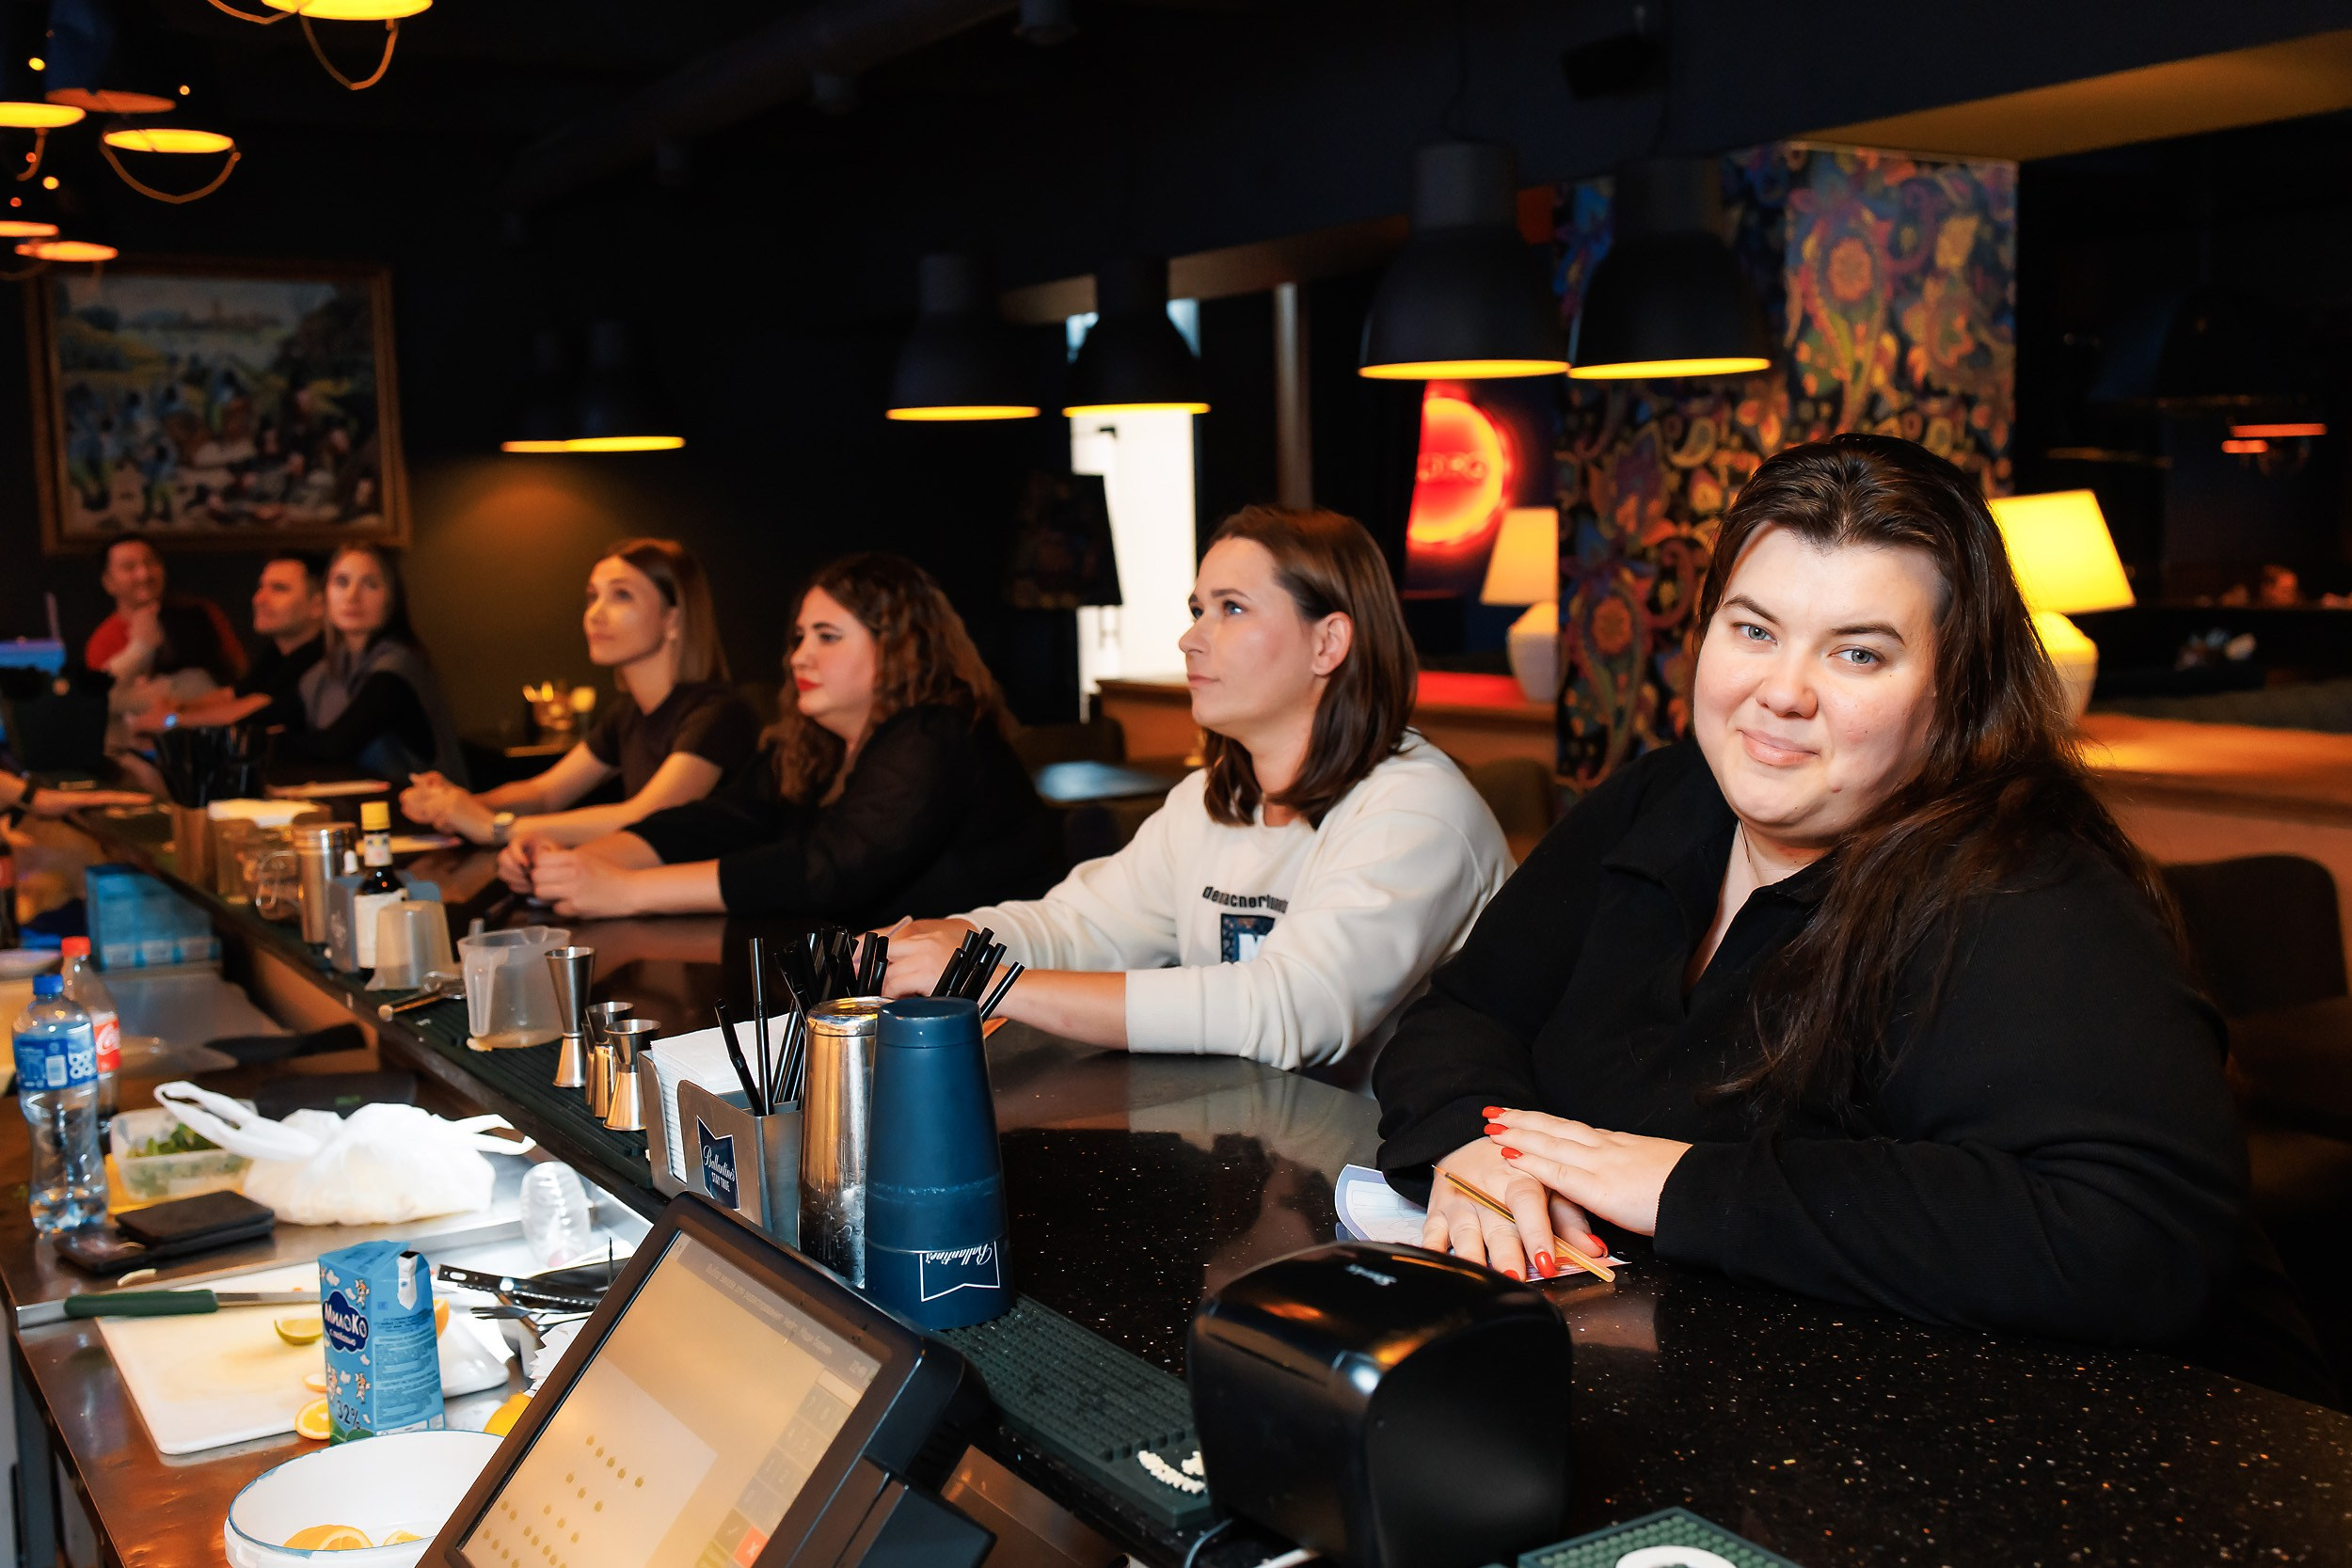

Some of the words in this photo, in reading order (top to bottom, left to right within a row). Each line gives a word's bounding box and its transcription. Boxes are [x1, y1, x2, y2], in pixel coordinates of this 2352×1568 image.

[703, 1145, 736, 1182] Ballantine's
[711, 1171, 721, 1186] STAY
[721, 1177, 731, 1193] TRUE
[925, 1243, 993, 1266] Ballantine's
